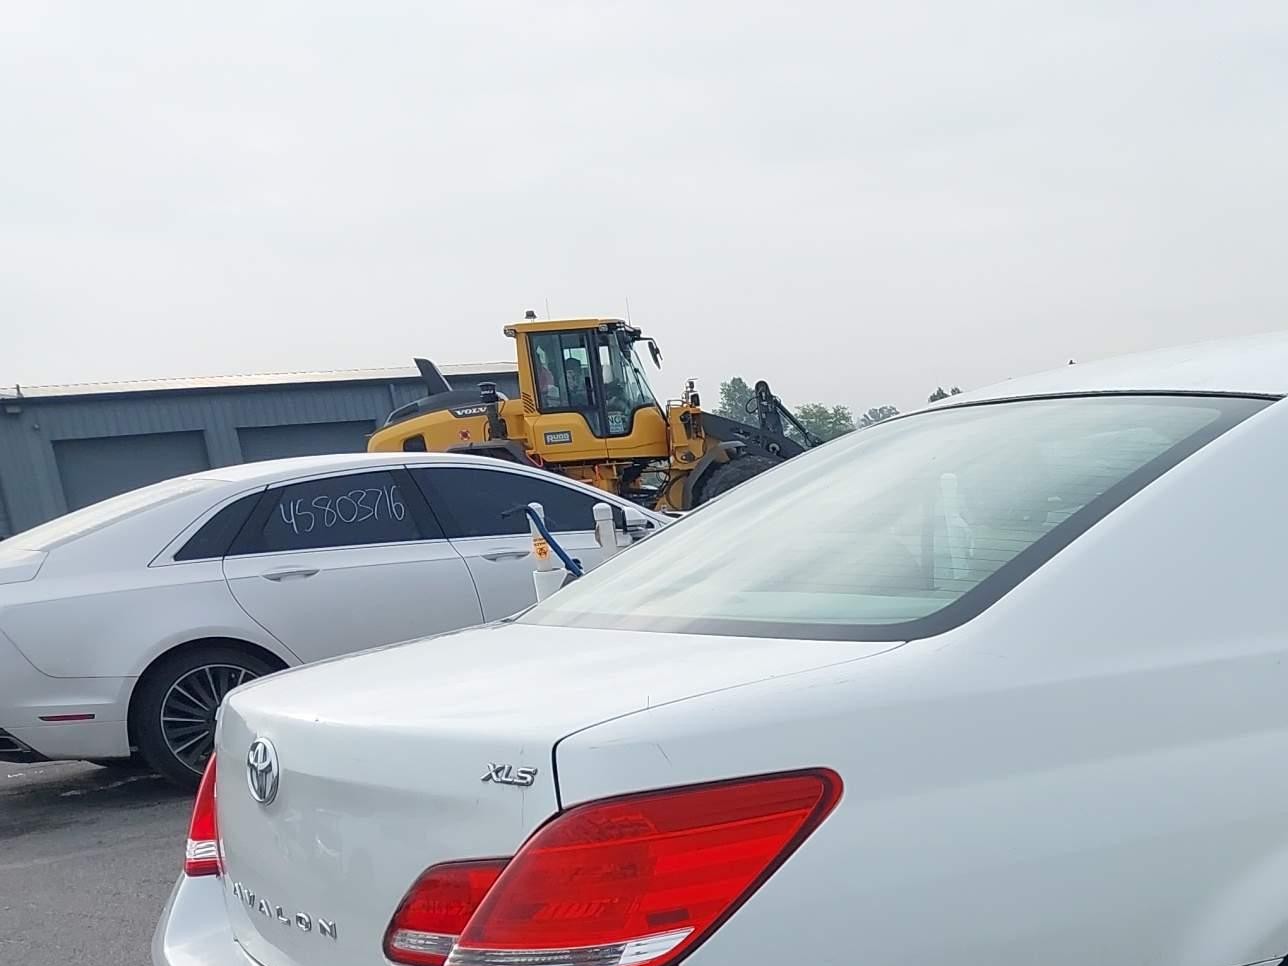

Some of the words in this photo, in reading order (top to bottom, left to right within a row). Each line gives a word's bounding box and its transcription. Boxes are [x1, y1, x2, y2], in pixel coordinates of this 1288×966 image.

[455, 406, 487, 416] VOLV
[280, 485, 405, 534] 45803716
[480, 762, 538, 787] XLS
[233, 882, 337, 940] AVALON
